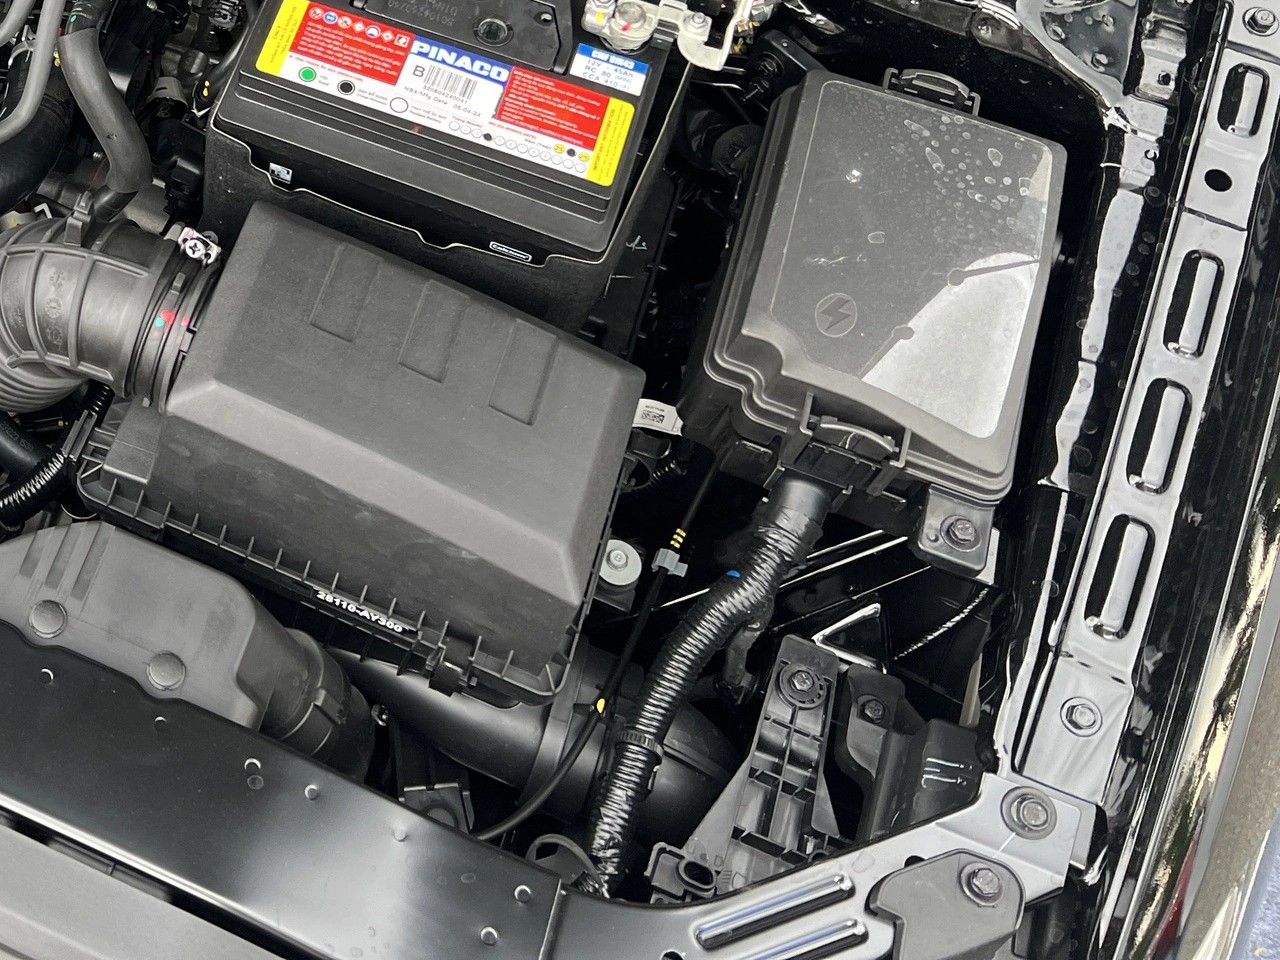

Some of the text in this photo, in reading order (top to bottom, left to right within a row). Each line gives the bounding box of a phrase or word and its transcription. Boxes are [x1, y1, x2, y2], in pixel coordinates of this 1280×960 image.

[410, 39, 510, 82] PINACO
[412, 64, 425, 78] B
[584, 64, 597, 73] RC
[600, 69, 611, 78] 80
[581, 71, 600, 82] CCA
[603, 78, 618, 87] 410
[432, 96, 448, 106] Date
[315, 589, 403, 633] 28110-AY300
